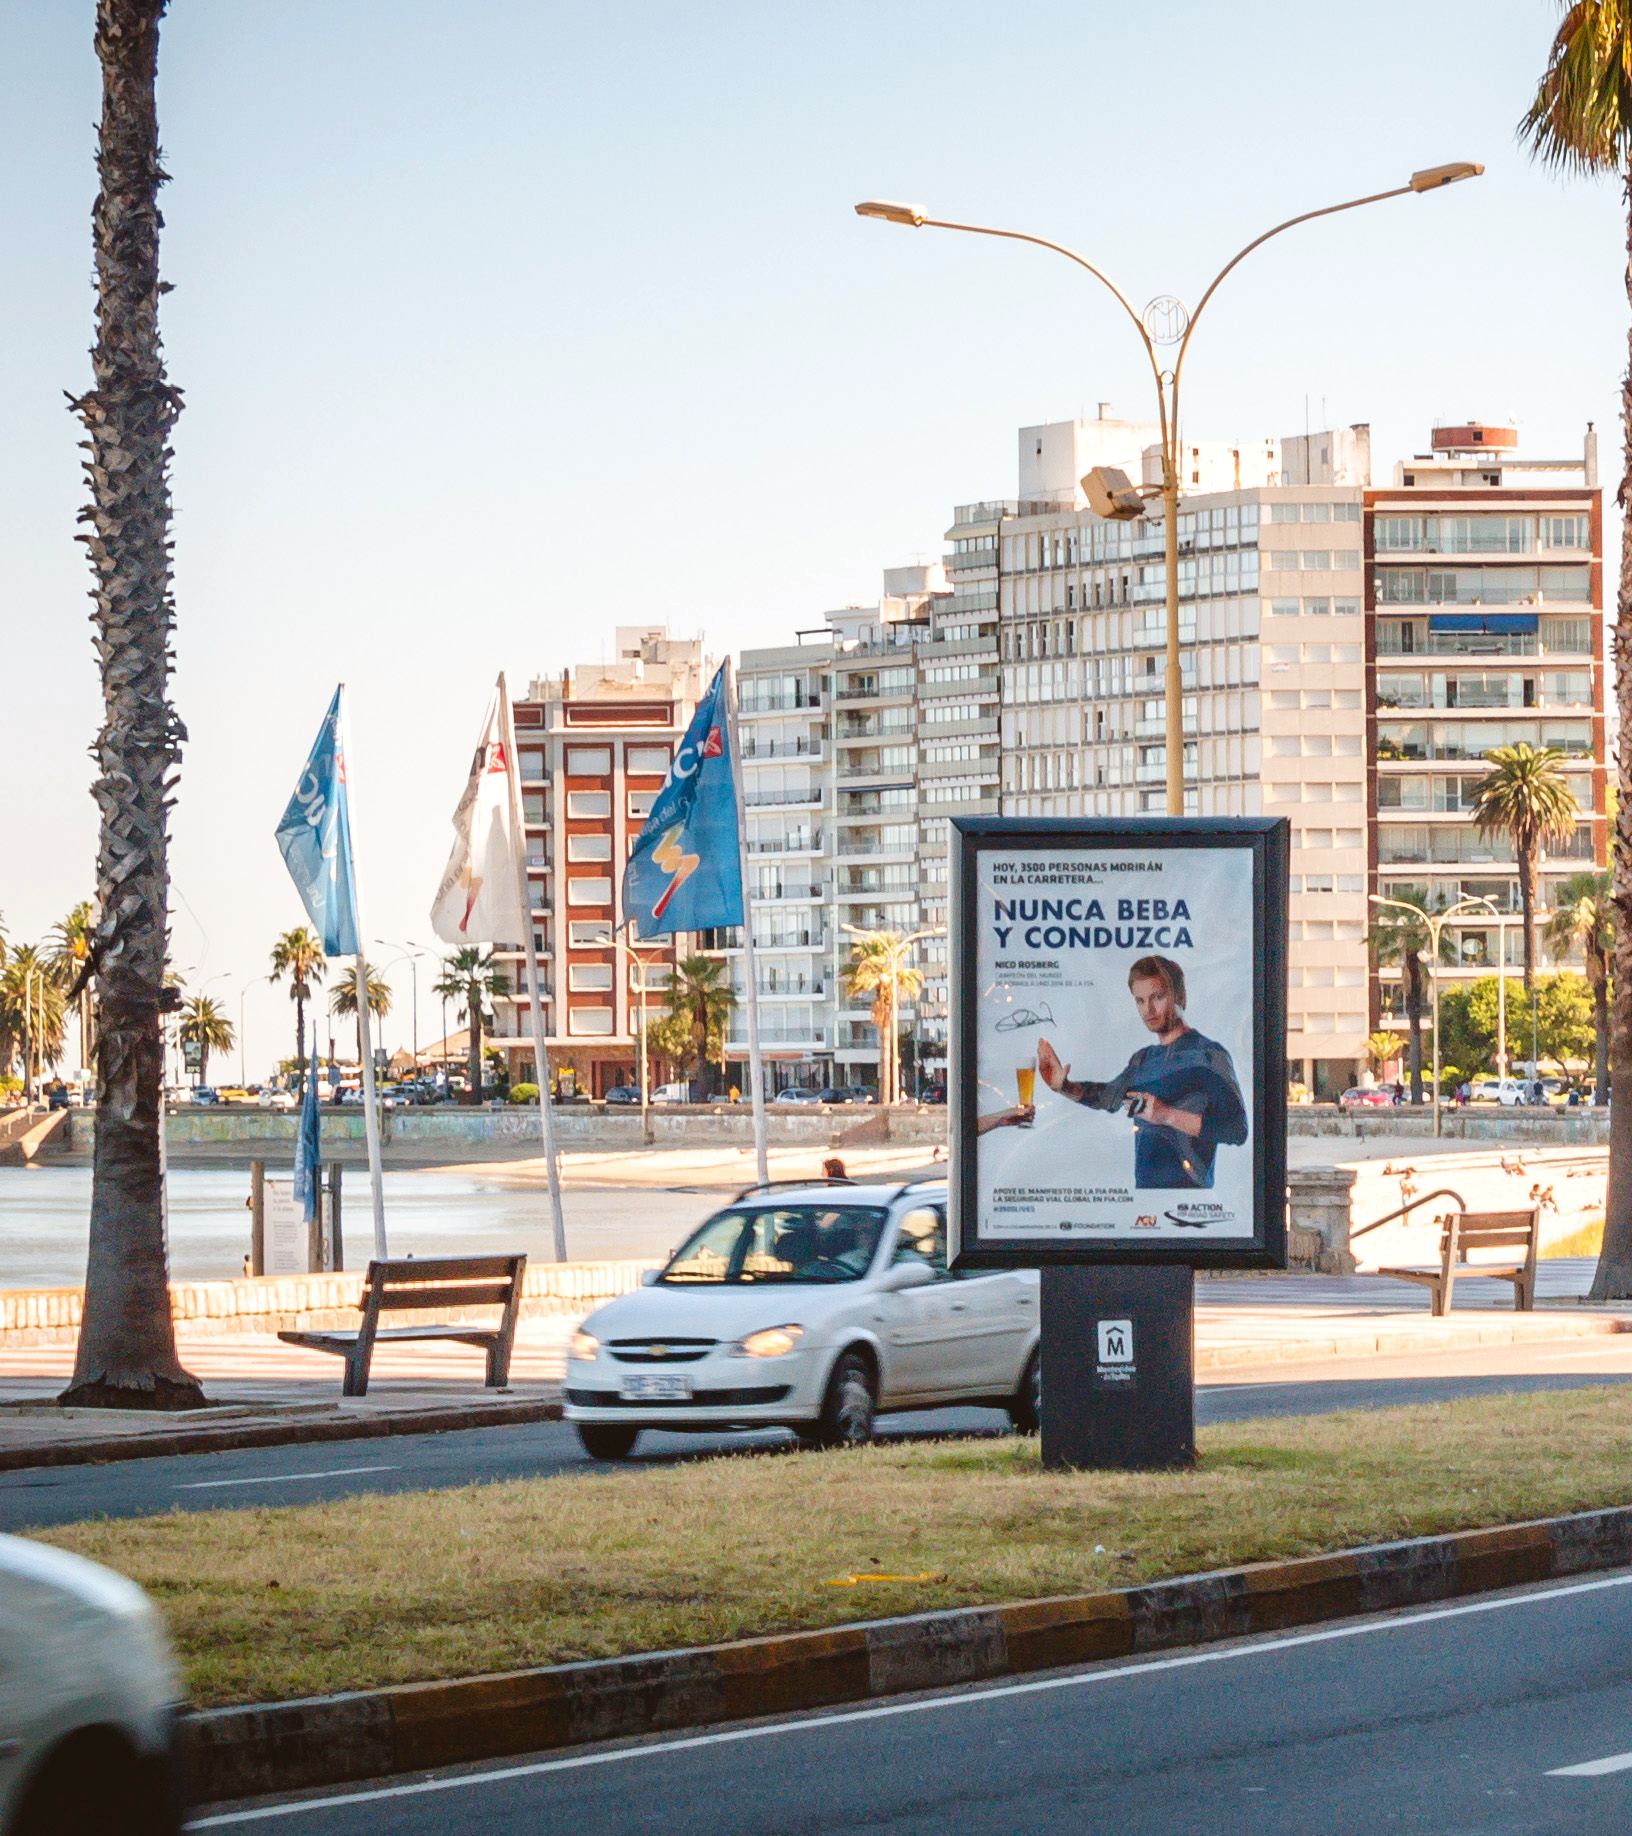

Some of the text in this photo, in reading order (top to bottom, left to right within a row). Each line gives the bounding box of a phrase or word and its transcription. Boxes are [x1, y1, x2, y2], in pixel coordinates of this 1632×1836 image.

[993, 862, 1017, 873] HOY,
[1020, 862, 1046, 872] 3500
[1048, 862, 1107, 872] PERSONAS
[993, 874, 1007, 884] EN
[1011, 874, 1024, 884] LA
[994, 899, 1191, 921] NUNCA BEBA
[993, 926, 1194, 949] Y CONDUZCA
